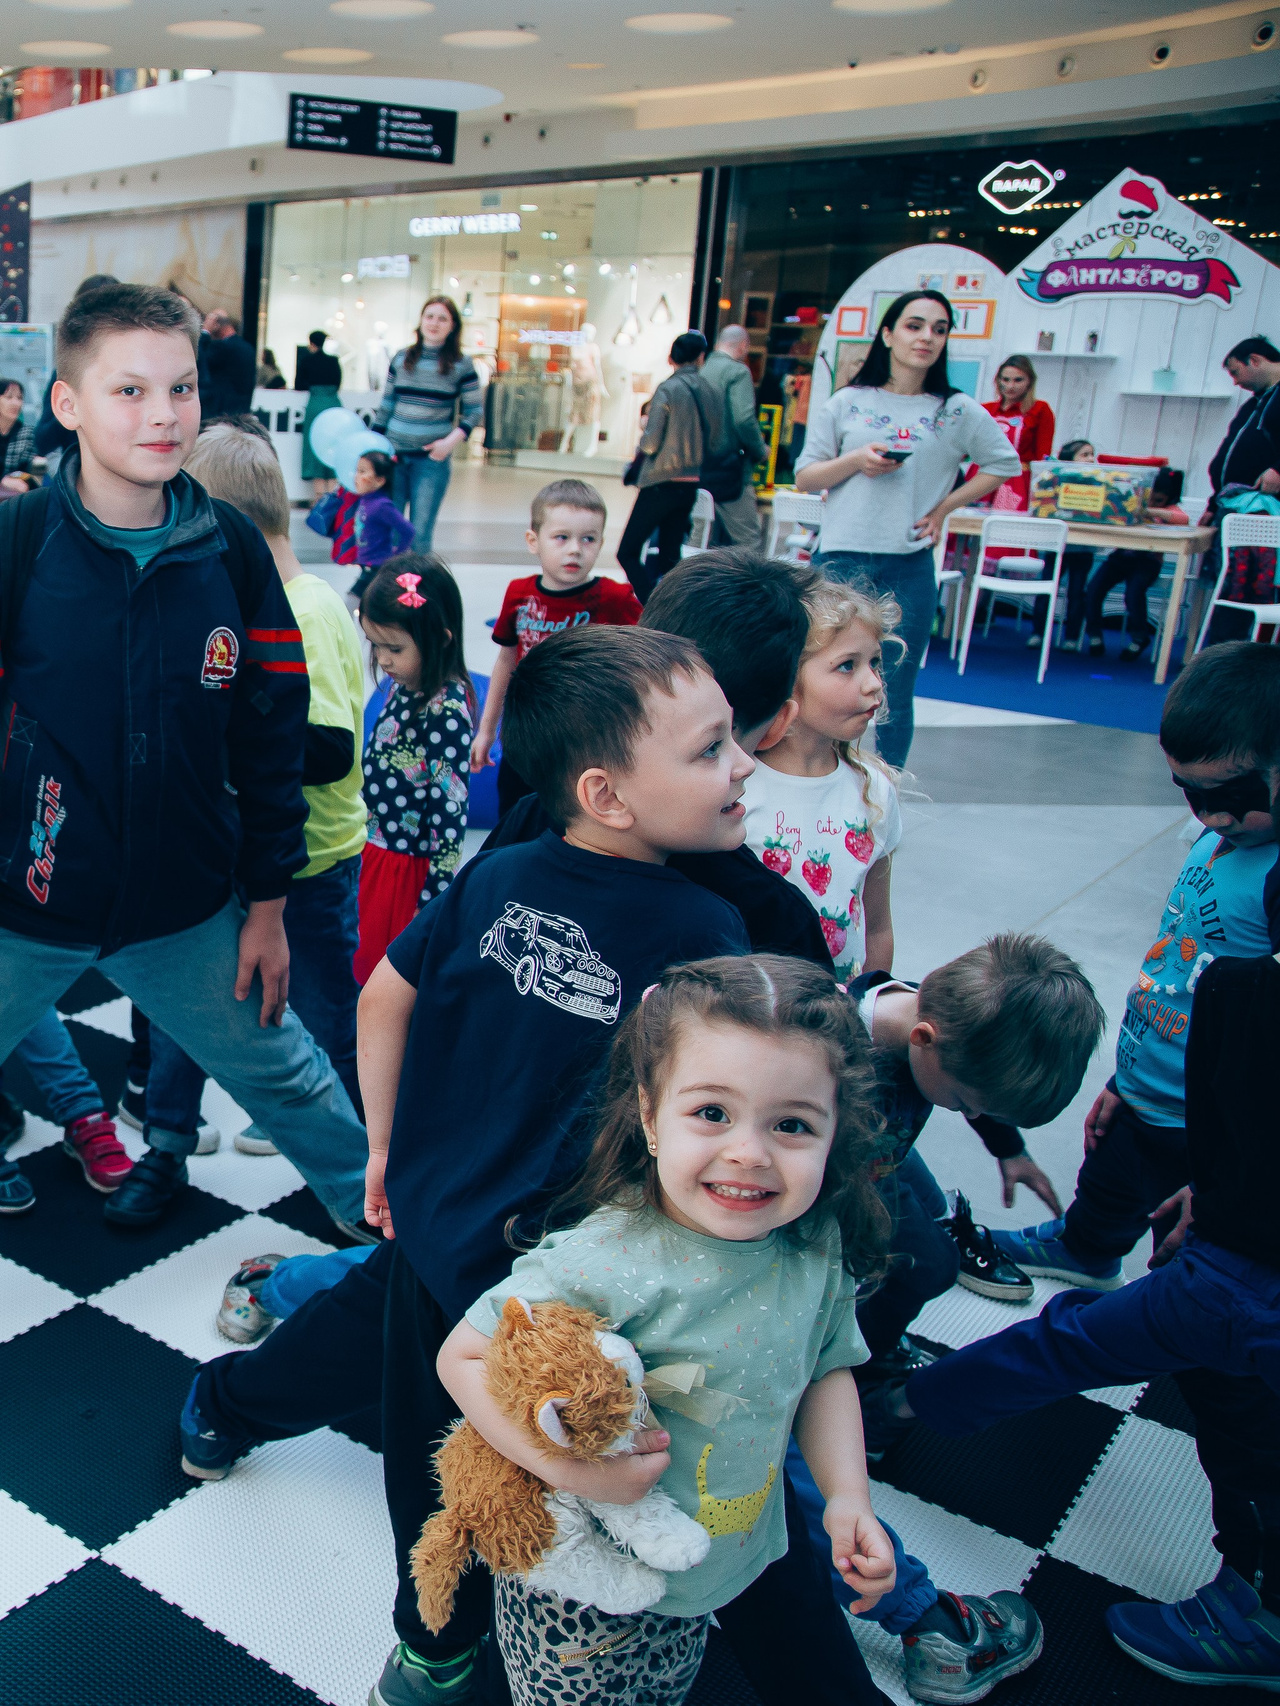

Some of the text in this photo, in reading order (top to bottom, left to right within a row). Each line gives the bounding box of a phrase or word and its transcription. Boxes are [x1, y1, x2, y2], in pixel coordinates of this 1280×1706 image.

[992, 178, 1041, 193] ПАРАД
[409, 213, 521, 237] GERRY WEBER
[1067, 221, 1201, 261] мастерская
[1046, 264, 1201, 291] ФАНТАЗЁРОВ
